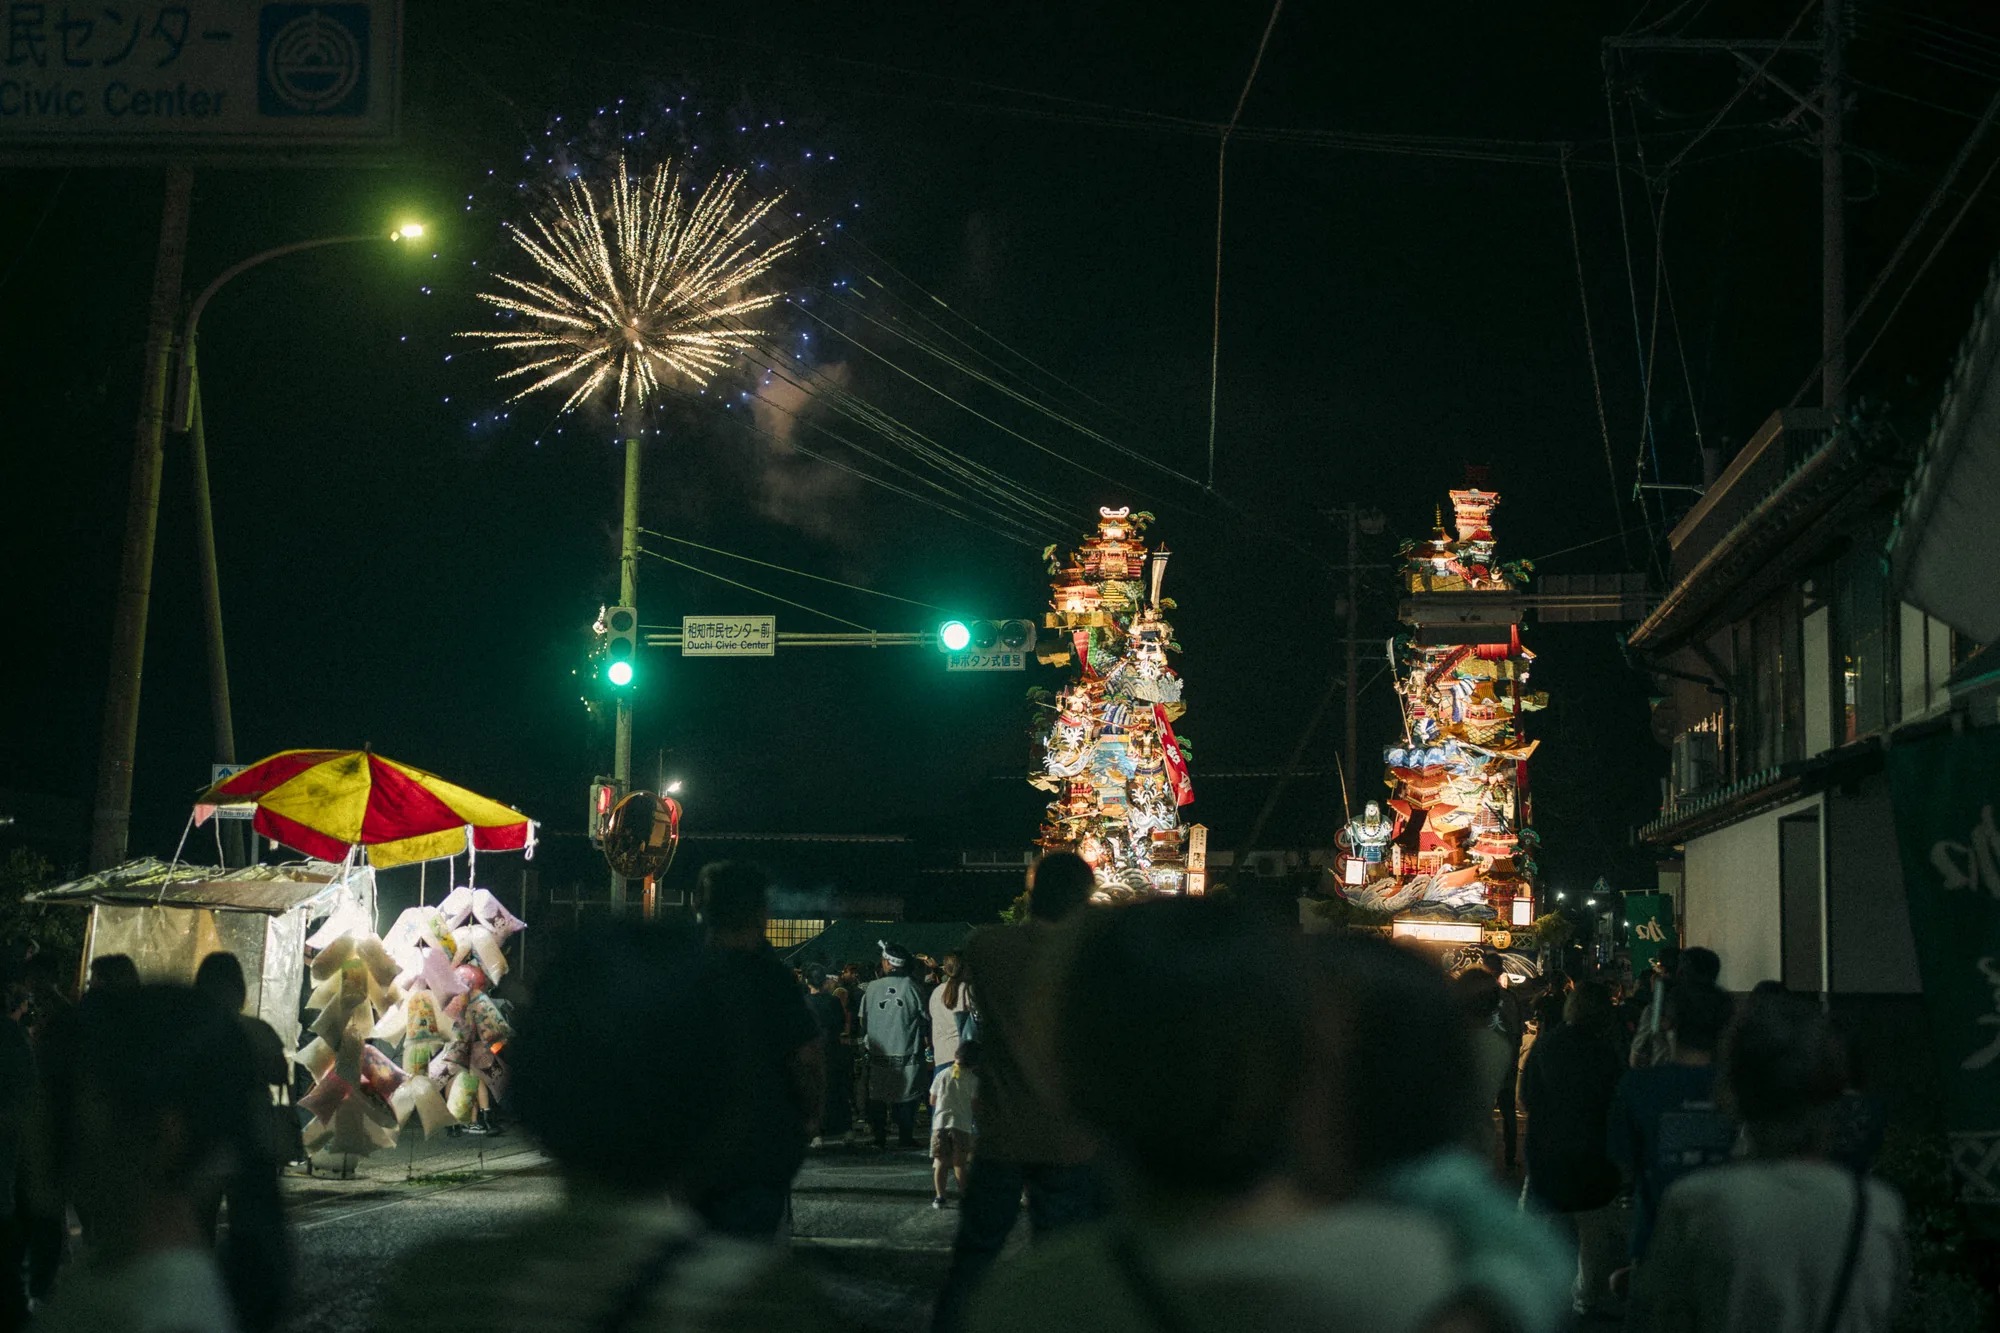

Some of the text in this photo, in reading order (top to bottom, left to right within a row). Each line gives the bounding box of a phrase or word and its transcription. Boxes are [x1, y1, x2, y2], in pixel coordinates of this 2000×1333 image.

[4, 3, 234, 68] 民センター
[0, 81, 227, 117] Civic Center
[687, 622, 771, 639] 相知市民センター前
[687, 640, 770, 650] Ouchi Civic Center
[949, 654, 1022, 669] 押ボタン式信号
